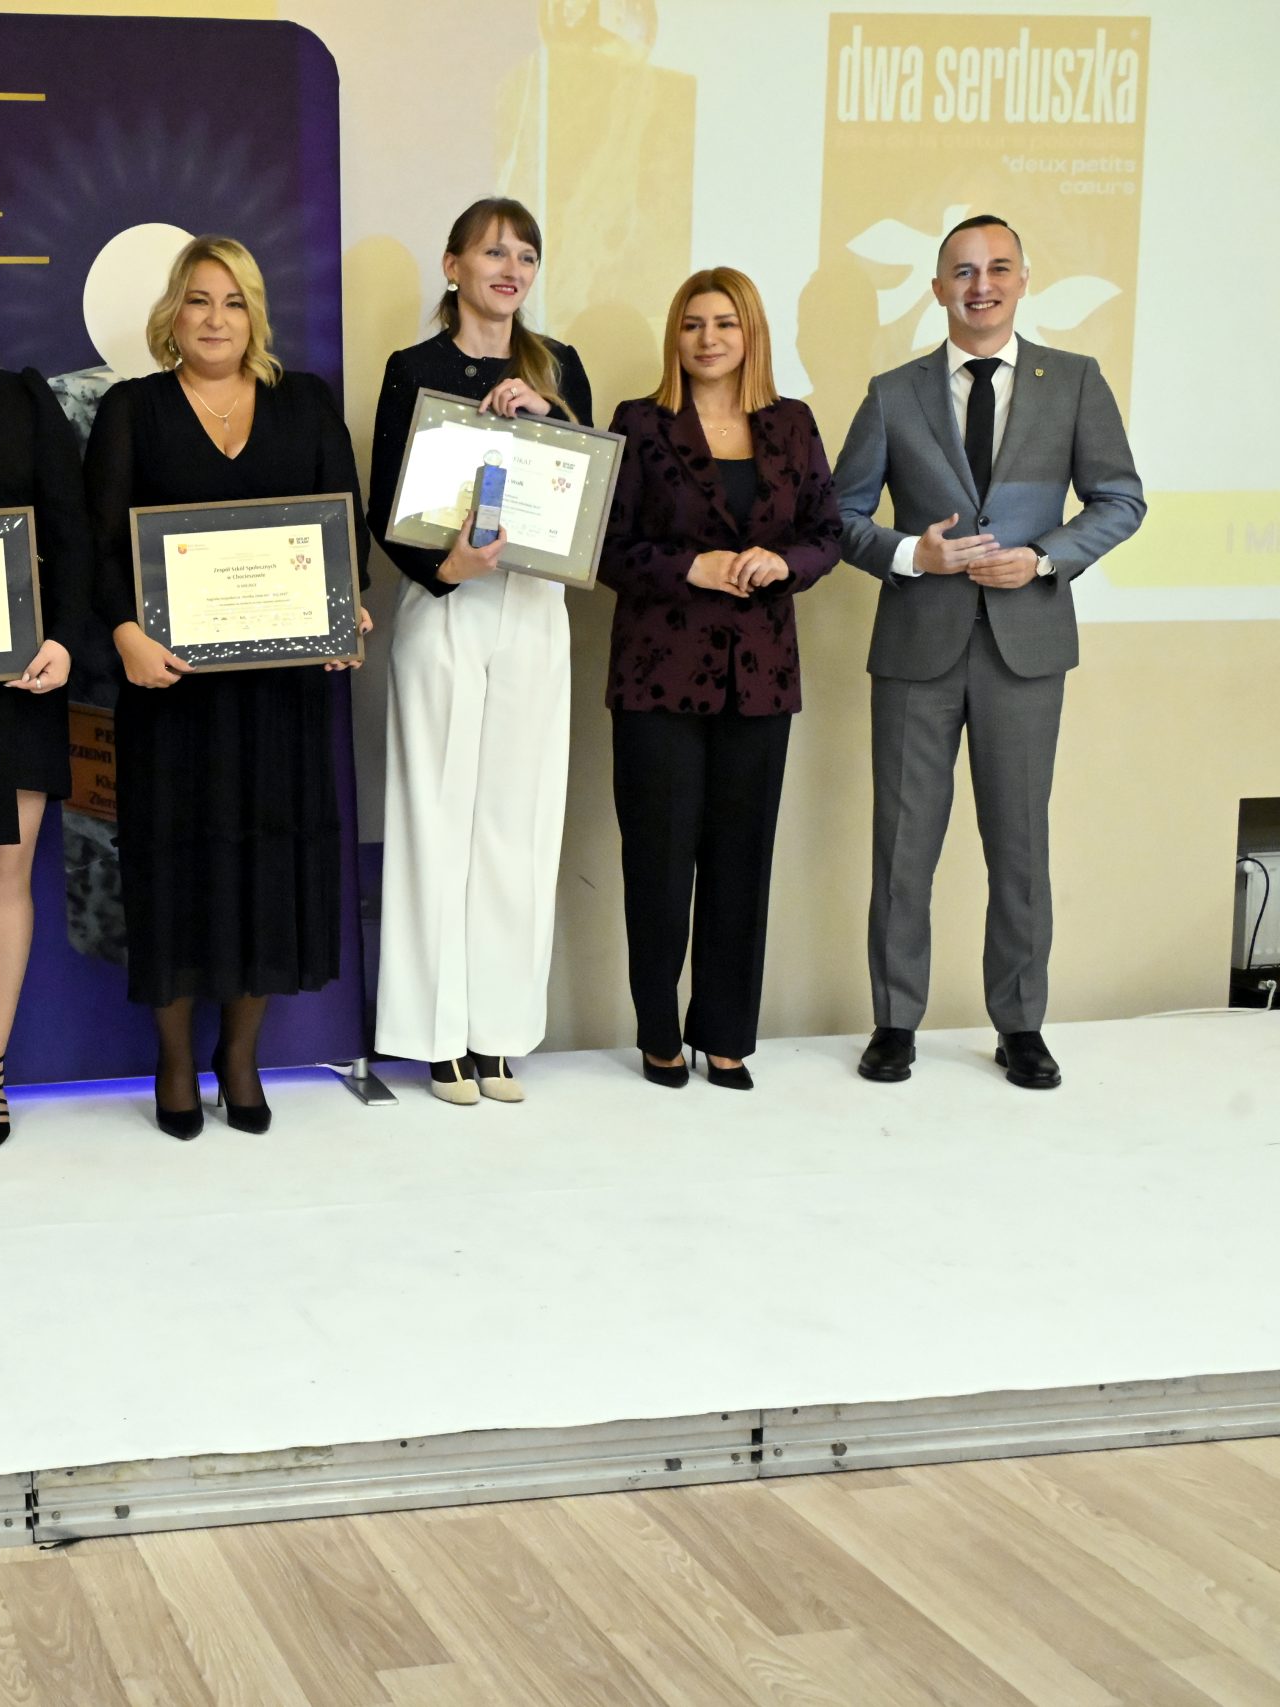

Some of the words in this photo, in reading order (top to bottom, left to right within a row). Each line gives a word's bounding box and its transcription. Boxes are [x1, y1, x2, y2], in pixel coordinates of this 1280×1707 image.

[837, 25, 923, 122] dwa
[934, 27, 1138, 124] serduszka
[1072, 156, 1136, 176] petits
